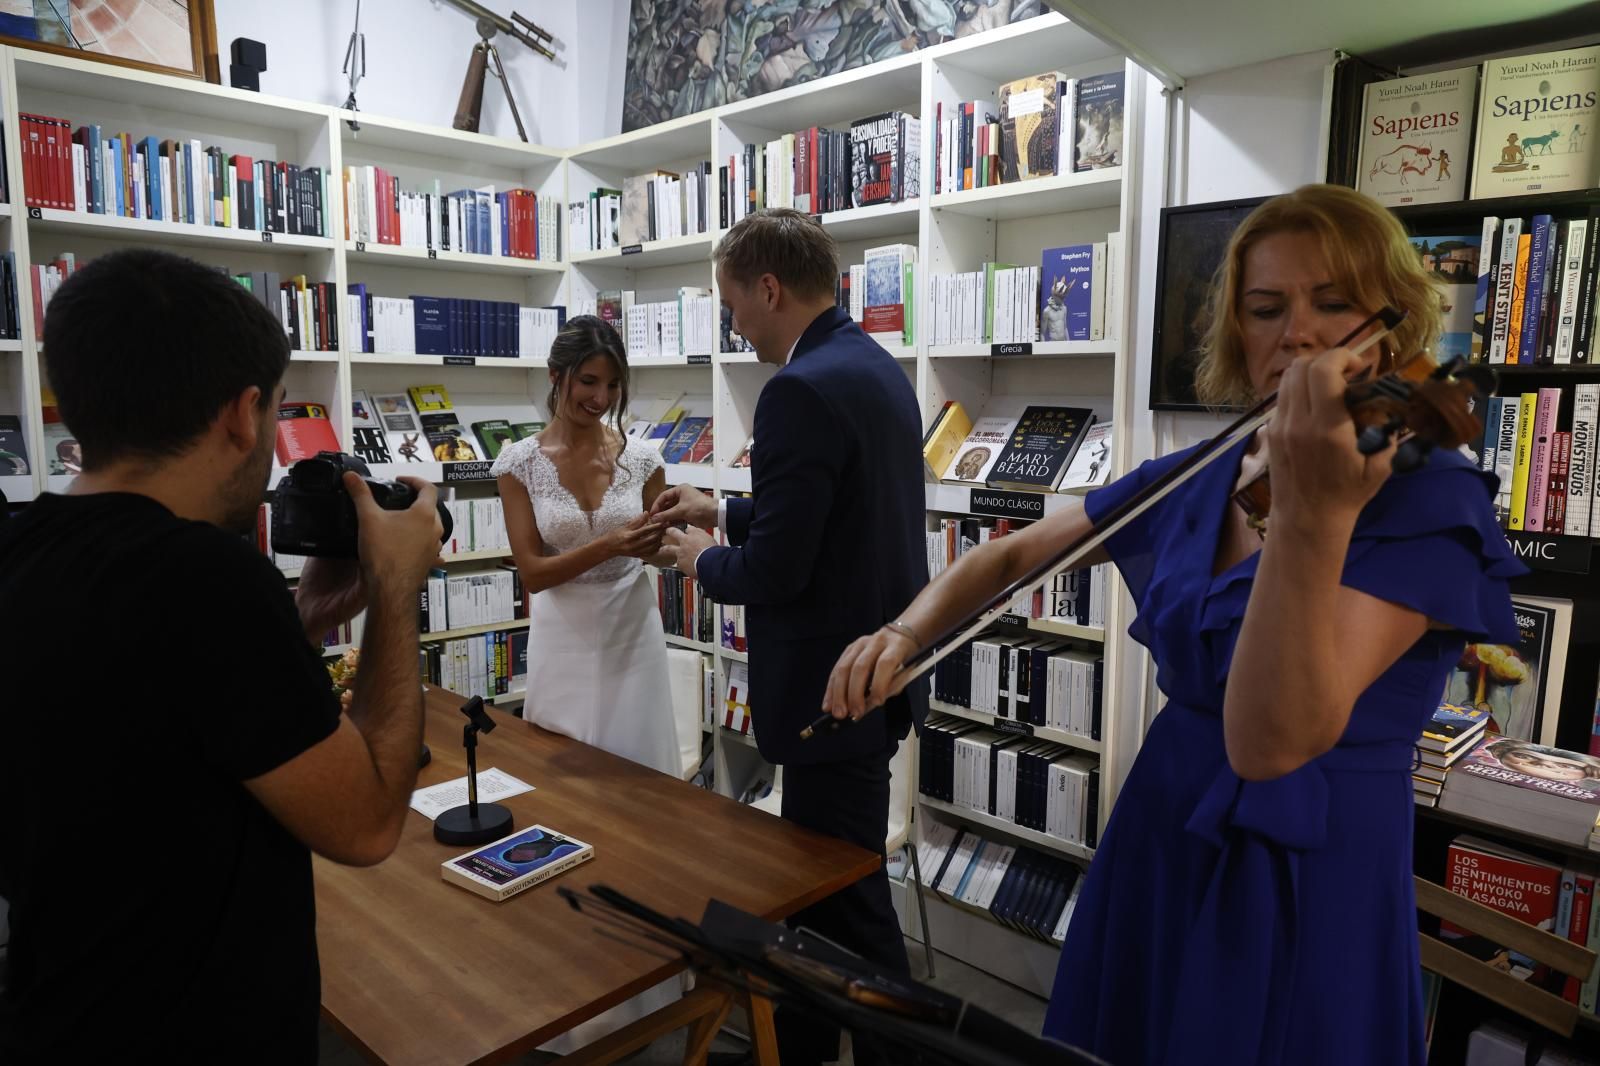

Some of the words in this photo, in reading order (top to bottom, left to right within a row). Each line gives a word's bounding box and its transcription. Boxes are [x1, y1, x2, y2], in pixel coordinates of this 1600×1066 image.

[1501, 64, 1528, 76] Yuval
[1531, 60, 1558, 72] Noah
[1562, 56, 1597, 68] Harari
[1379, 86, 1402, 97] Yuval
[1404, 82, 1428, 93] Noah
[1430, 78, 1460, 88] Harari
[1492, 91, 1596, 122] Sapiens
[851, 118, 892, 144] PERSONALIDAD
[1372, 111, 1459, 140] Sapiens
[868, 138, 872, 156] Y
[873, 136, 892, 155] PODER
[32, 208, 40, 218] G
[263, 232, 272, 242] H
[1534, 223, 1546, 250] Alison
[1530, 252, 1543, 284] Bechdel
[1499, 263, 1513, 299] KENT
[1494, 301, 1509, 342] STATE
[1000, 344, 1023, 354] Grecia
[454, 463, 490, 471] FILOSOFÍA
[1006, 451, 1054, 465] MARY
[1570, 420, 1588, 496] MONSTRUOS
[997, 462, 1050, 477] BEARD
[974, 496, 1005, 509] MUNDO
[1006, 496, 1041, 511] CLÁSICO
[1454, 854, 1478, 867] LOS
[1453, 875, 1469, 888] DE
[1472, 880, 1522, 900] MIYOKO
[1454, 865, 1551, 895] SENTIMIENTOS
[1452, 887, 1469, 898] EN
[1472, 892, 1530, 913] ASAGAYA
